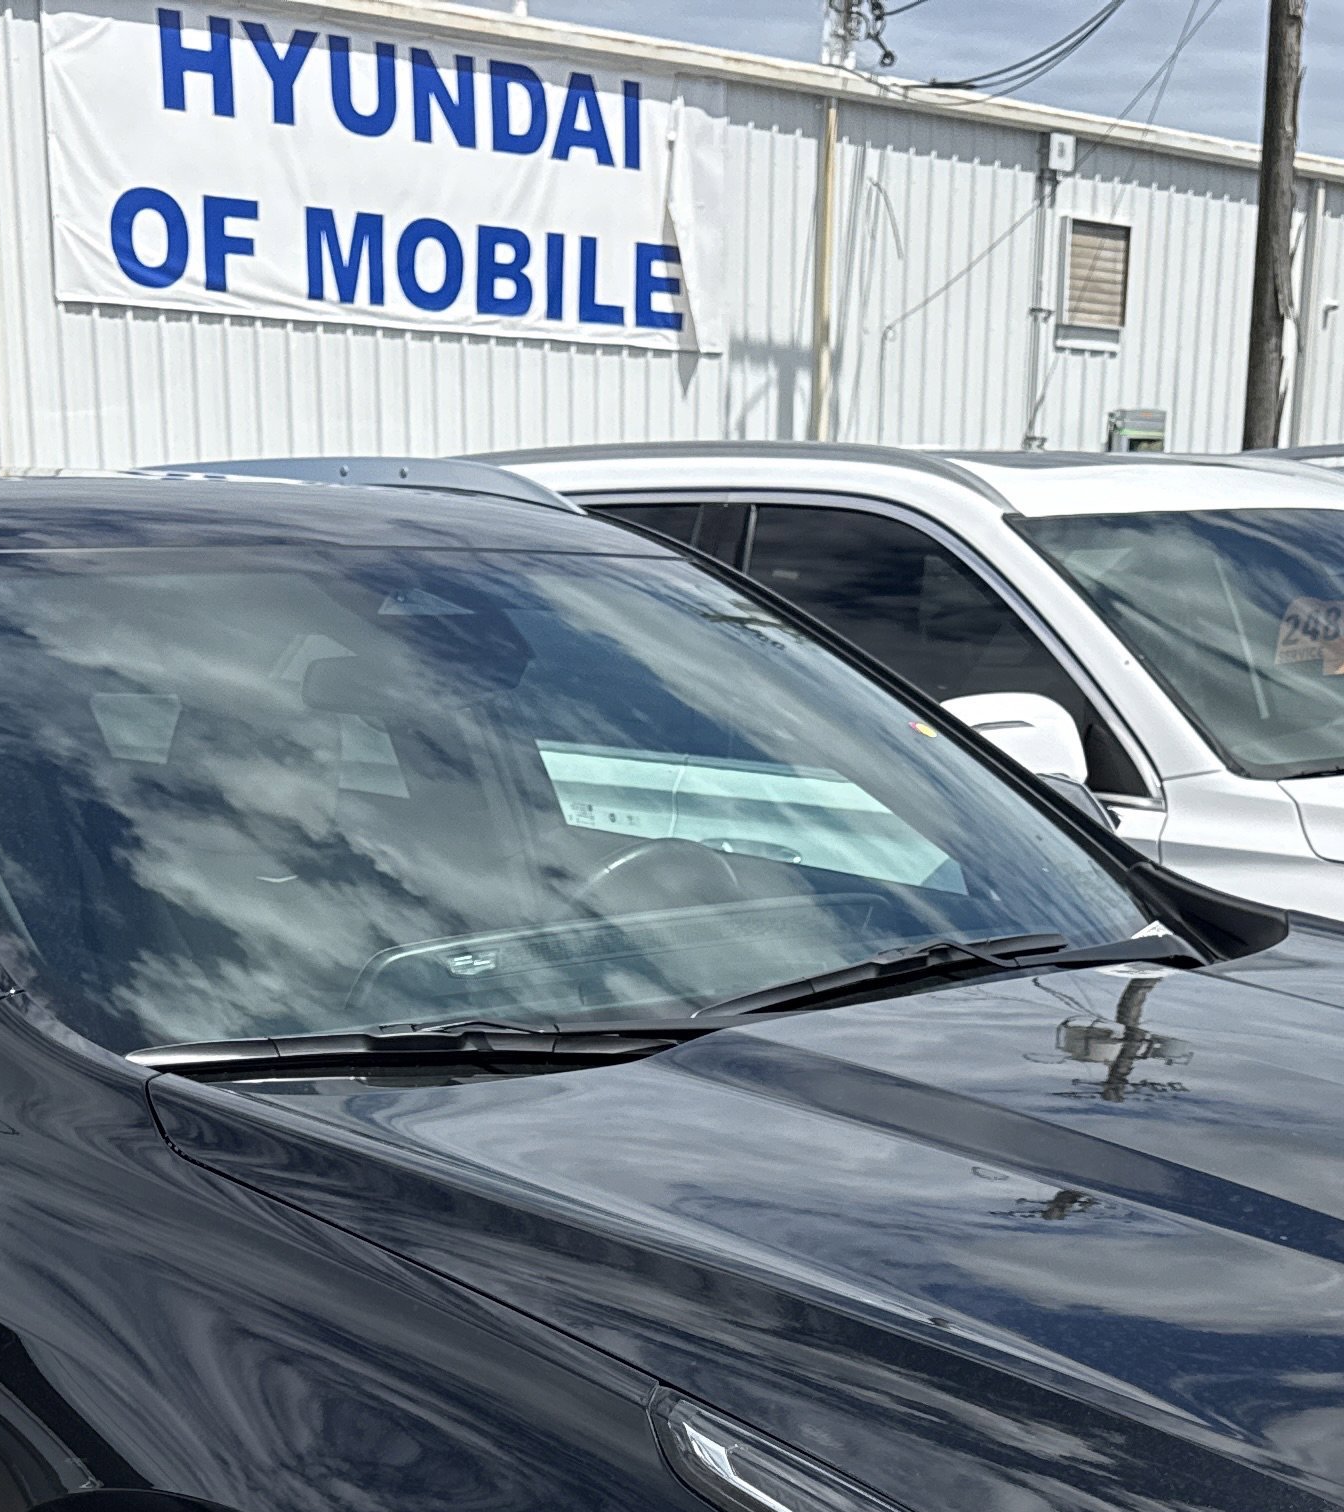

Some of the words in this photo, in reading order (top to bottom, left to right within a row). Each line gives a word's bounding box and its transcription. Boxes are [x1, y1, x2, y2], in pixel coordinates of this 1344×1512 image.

[157, 8, 642, 172] HYUNDAI
[110, 186, 259, 292] OF
[305, 205, 684, 332] MOBILE
